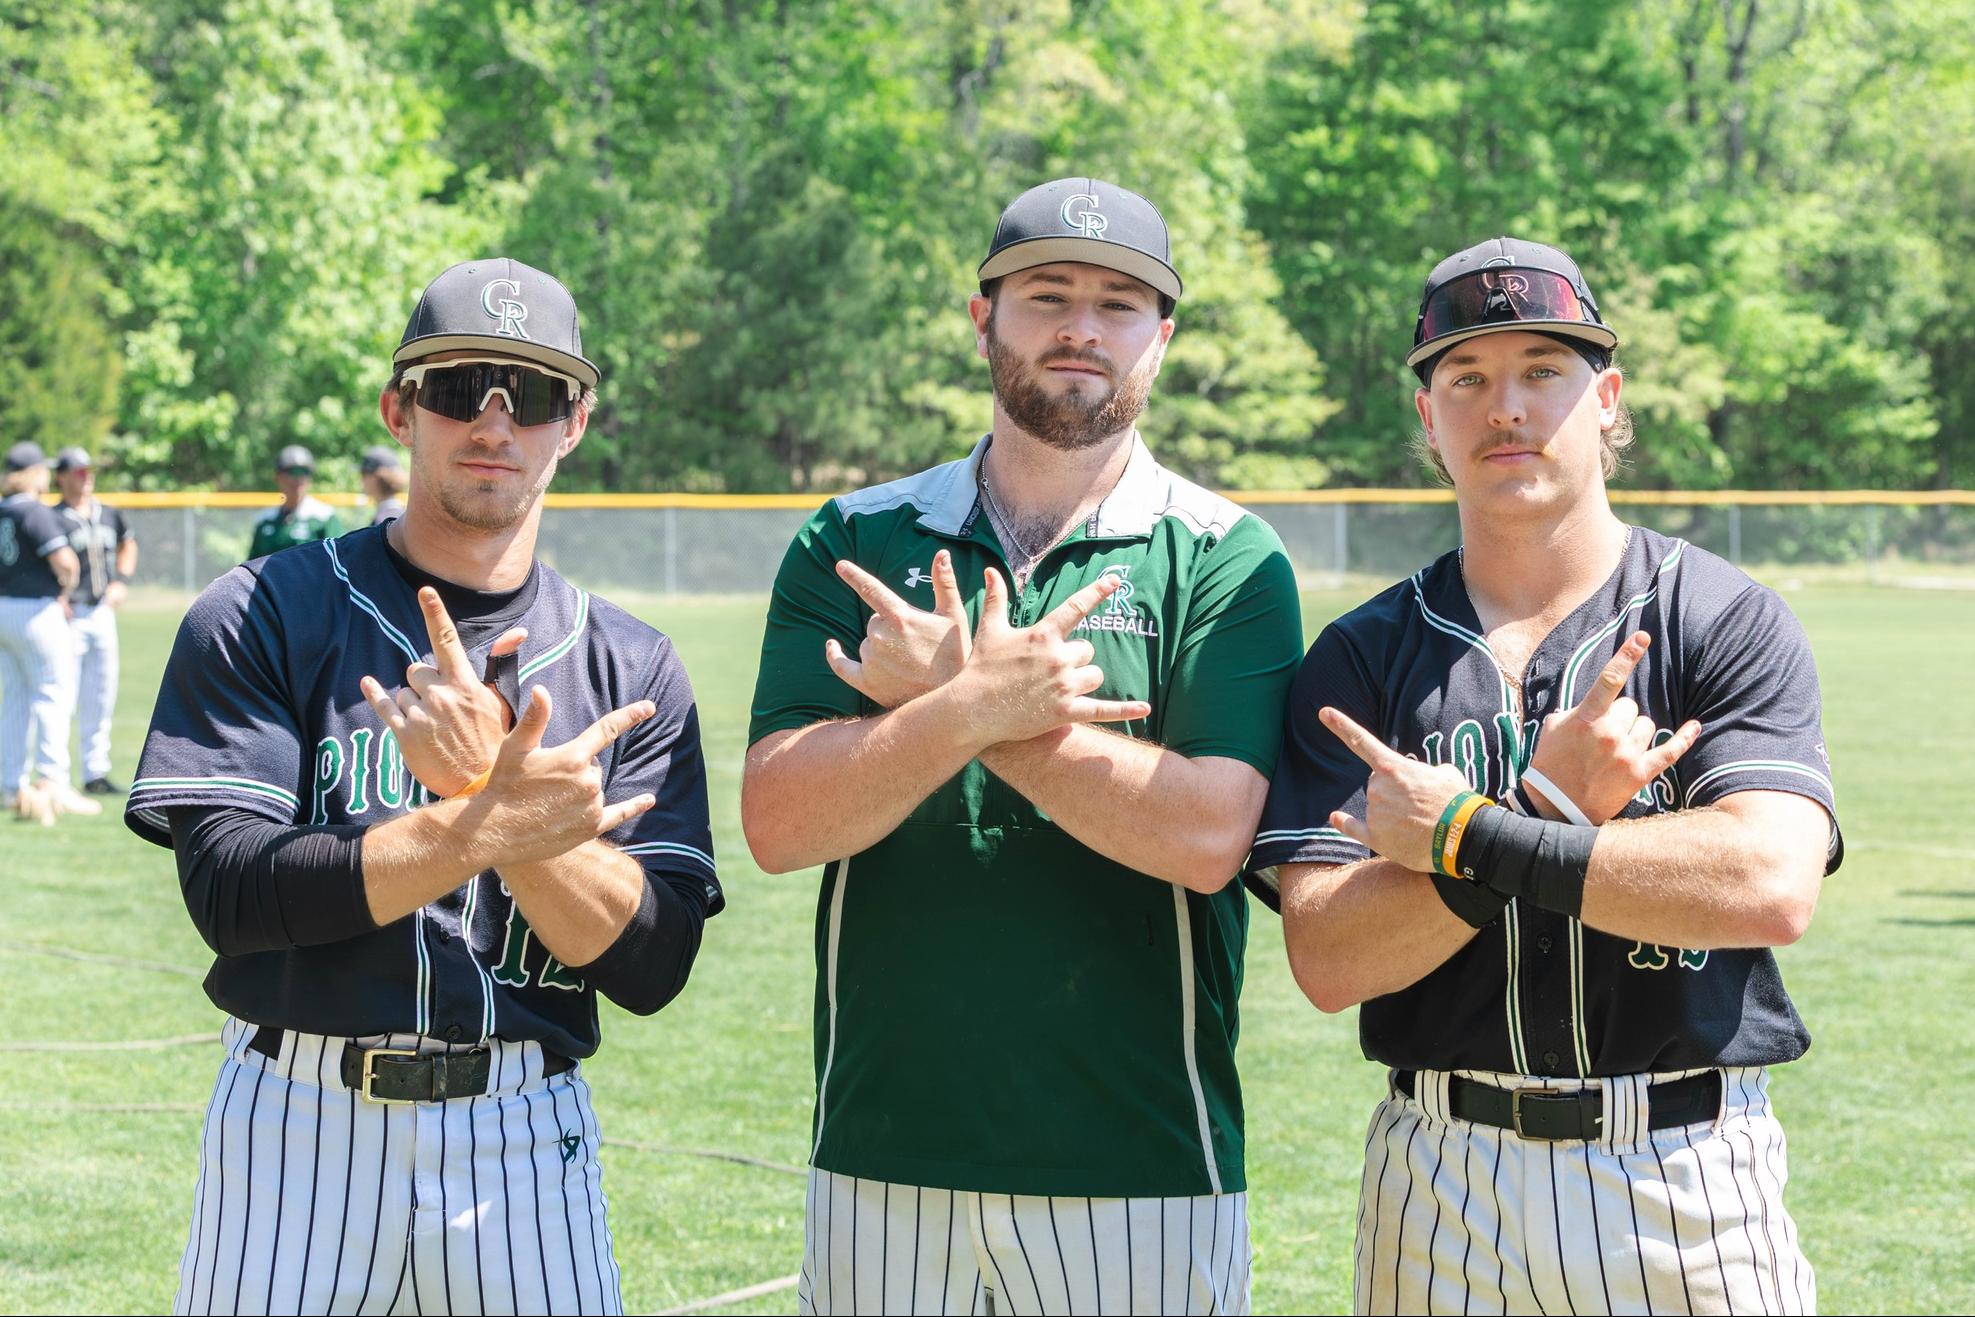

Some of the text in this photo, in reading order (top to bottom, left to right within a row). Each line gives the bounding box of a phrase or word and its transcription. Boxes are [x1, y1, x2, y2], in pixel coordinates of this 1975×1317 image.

[1060, 193, 1108, 239] CR
[480, 278, 530, 340] CR
[1073, 614, 1158, 637] ASEBALL
